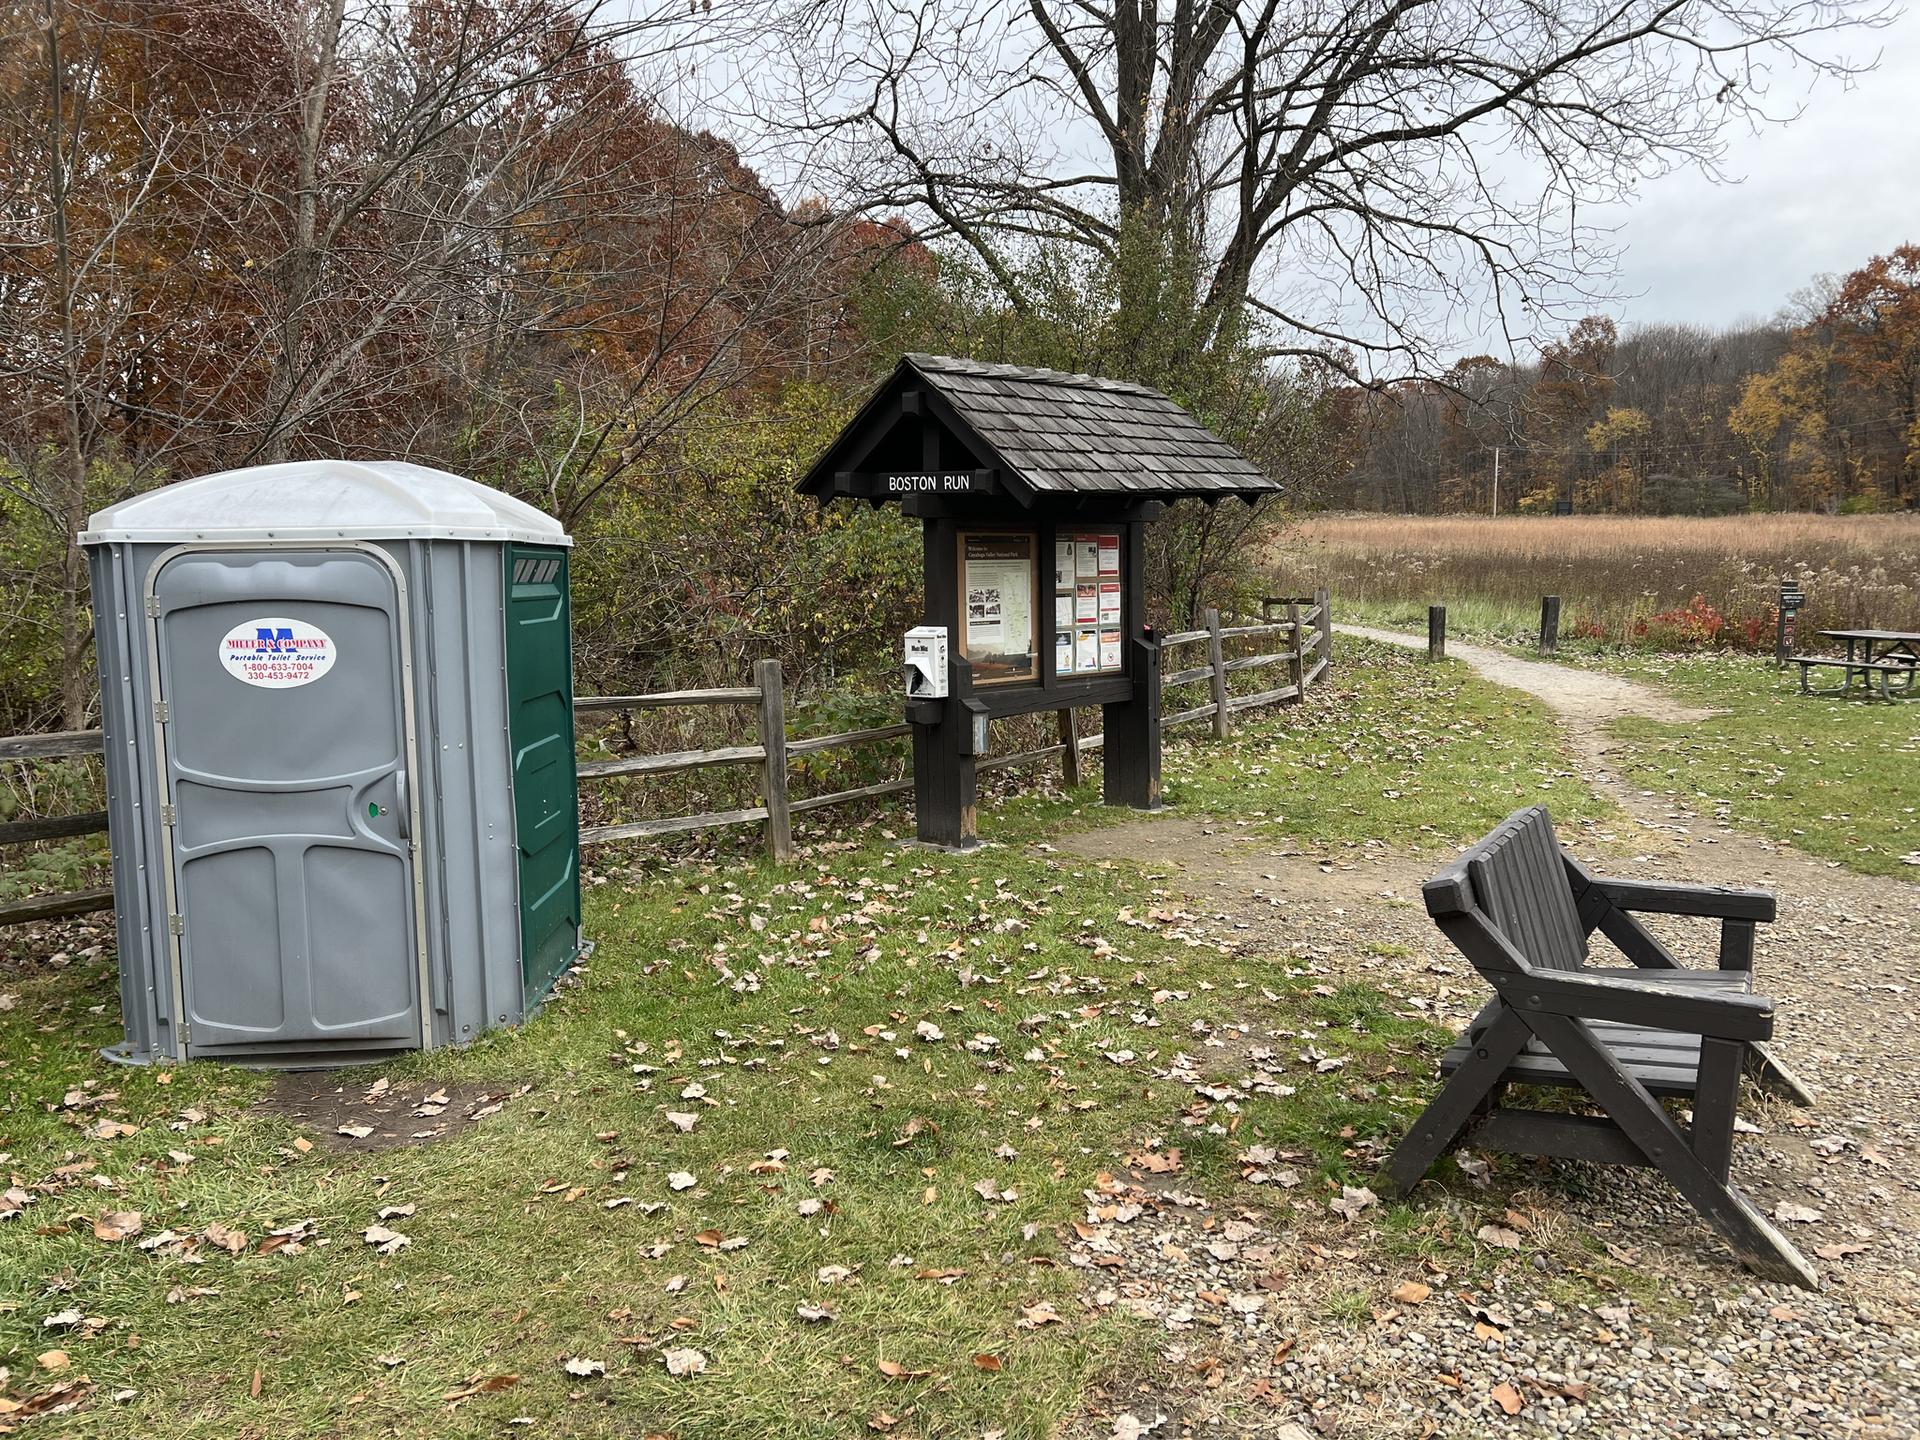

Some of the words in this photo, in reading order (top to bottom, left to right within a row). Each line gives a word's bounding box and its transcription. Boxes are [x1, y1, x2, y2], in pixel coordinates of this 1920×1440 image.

[889, 475, 937, 491] BOSTON
[944, 475, 970, 490] RUN
[266, 639, 275, 649] &
[276, 639, 327, 649] COMPANY
[243, 663, 314, 671] 1-800-633-7004
[248, 671, 310, 680] 330-453-9472
